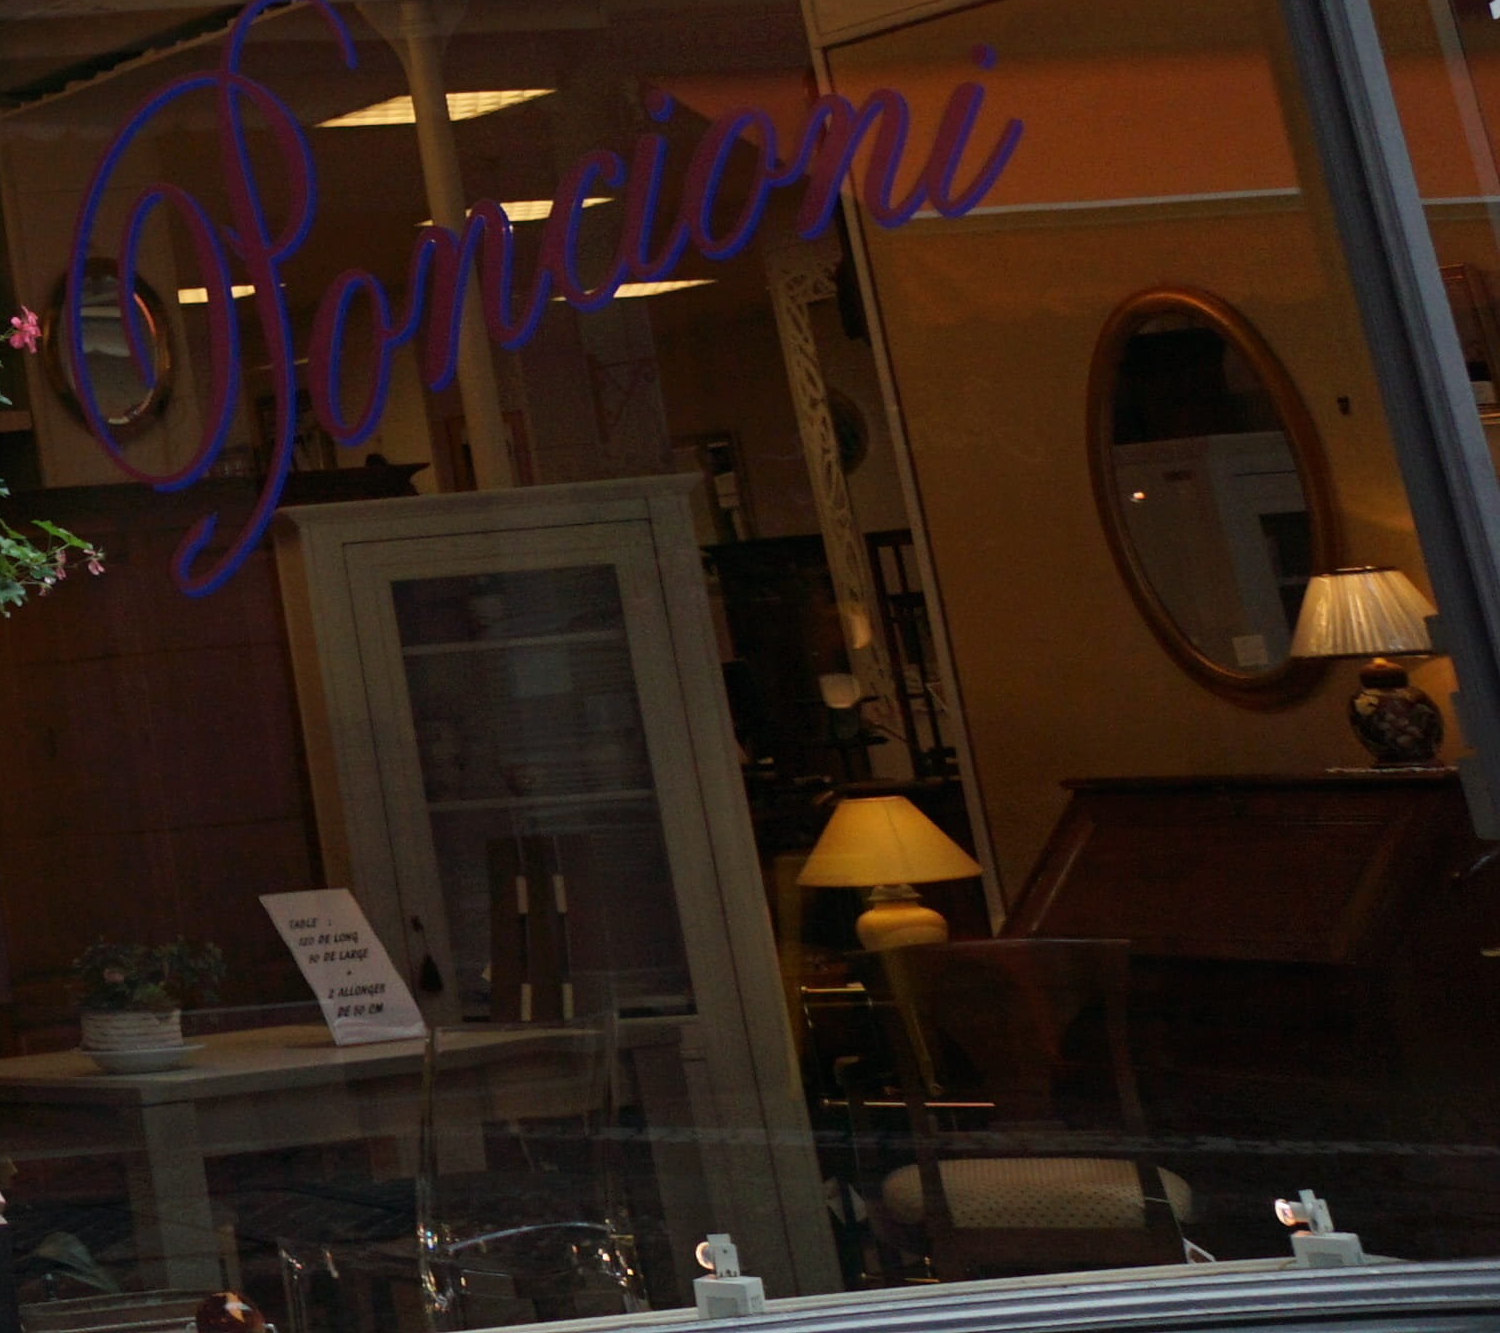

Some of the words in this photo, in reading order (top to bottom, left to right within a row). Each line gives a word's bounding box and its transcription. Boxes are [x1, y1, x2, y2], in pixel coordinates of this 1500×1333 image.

[290, 918, 317, 930] TABLE
[318, 934, 330, 945] DE
[334, 932, 359, 944] LONG
[323, 950, 336, 962] DE
[339, 948, 368, 961] LARGE
[338, 984, 386, 997] ALLONGES
[337, 1004, 351, 1018] DE
[368, 1003, 384, 1014] CM
